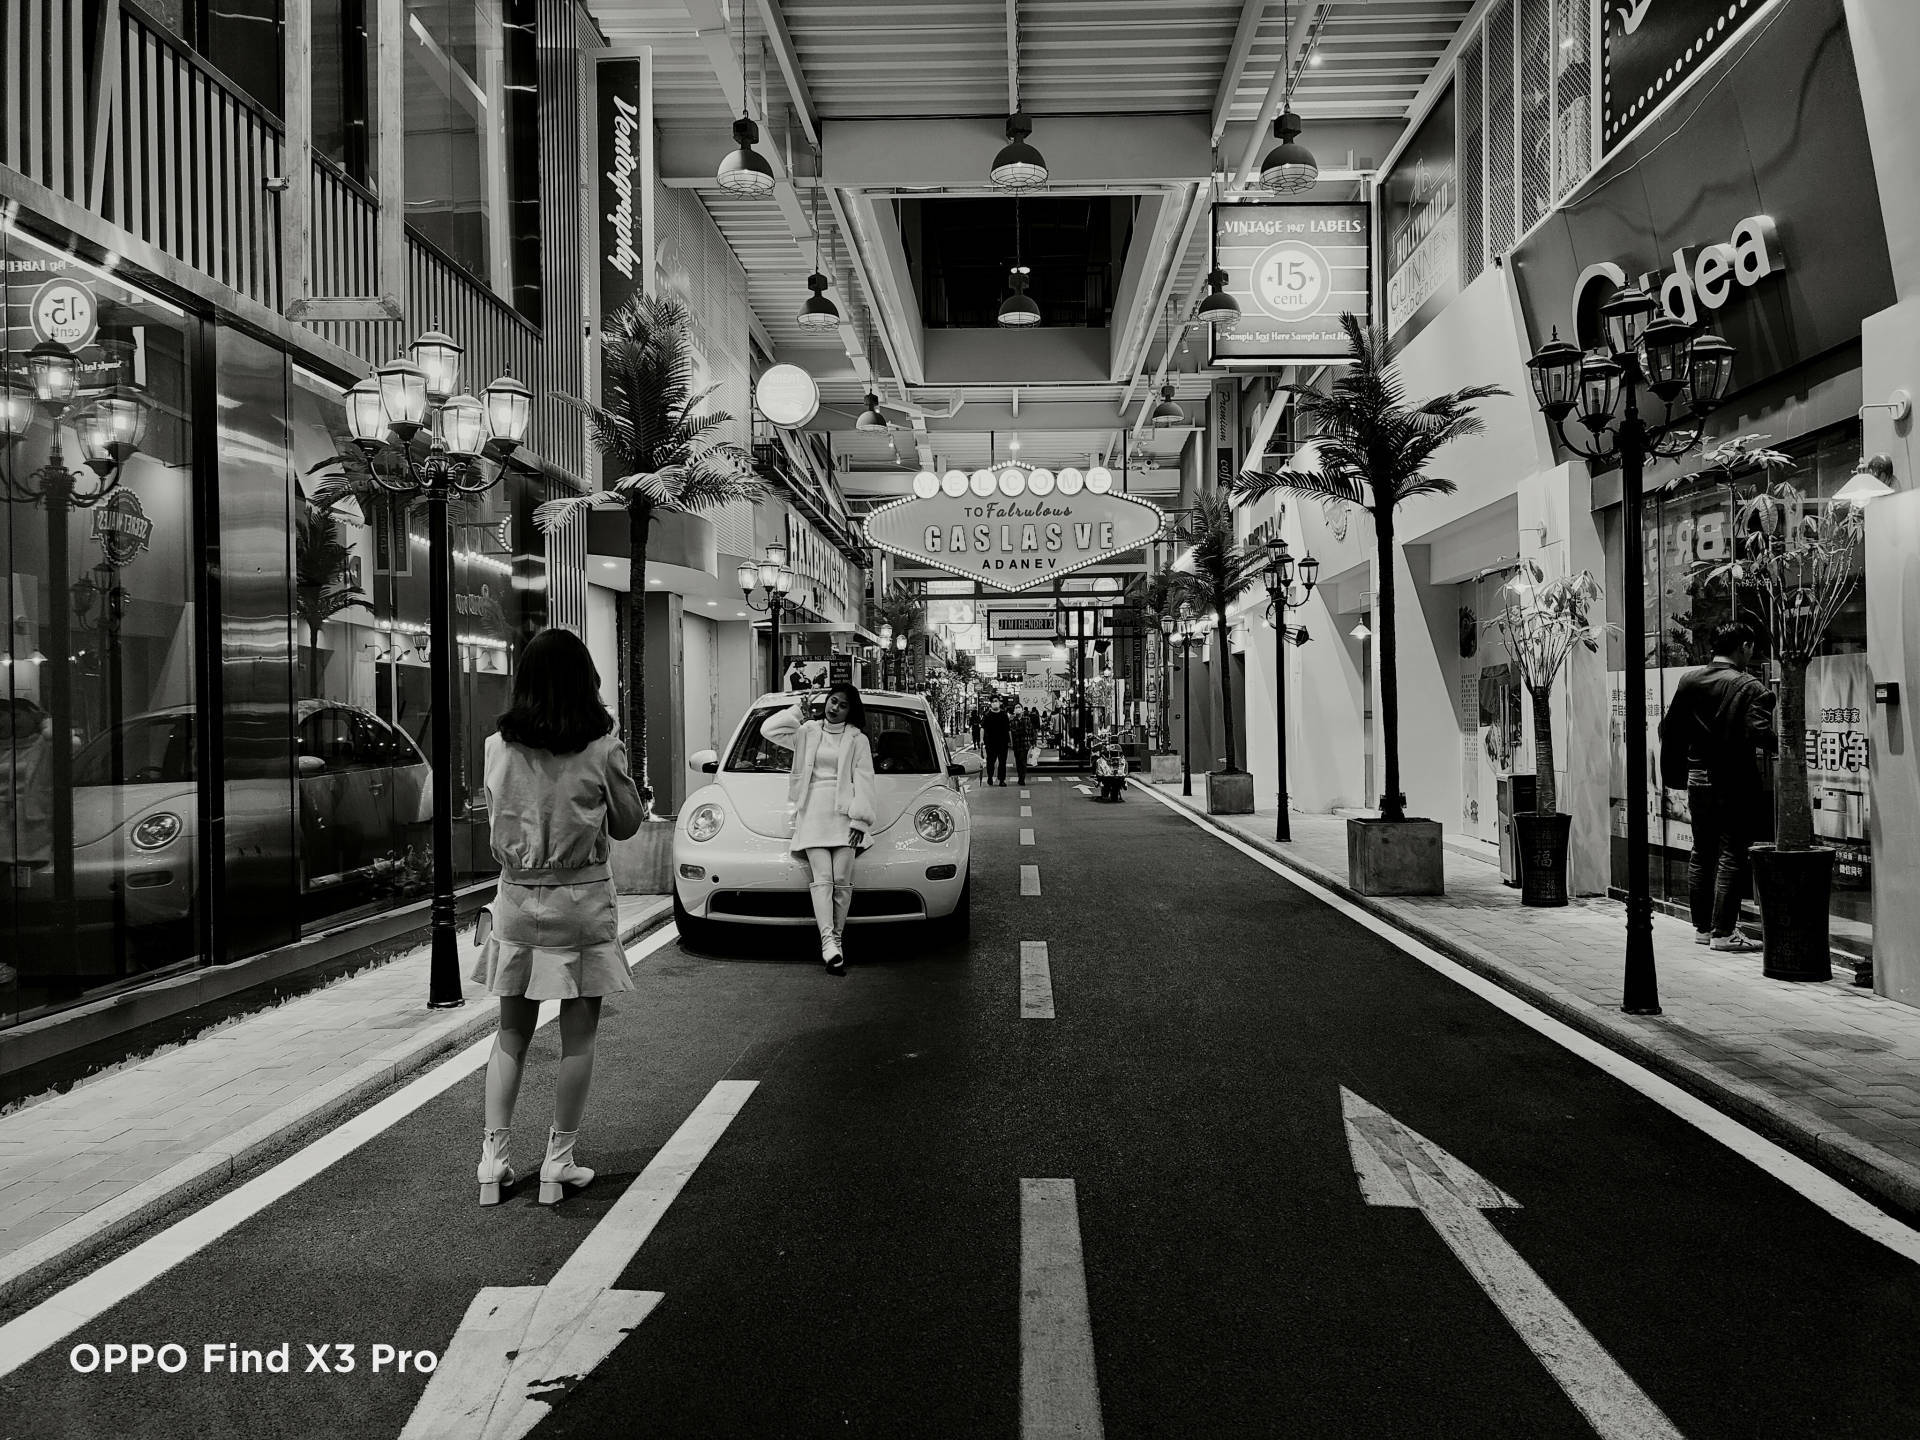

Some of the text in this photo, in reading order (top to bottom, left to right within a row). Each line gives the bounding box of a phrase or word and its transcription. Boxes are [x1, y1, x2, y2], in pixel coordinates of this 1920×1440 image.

[606, 95, 641, 280] Ventography
[1225, 220, 1361, 236] VINTAGE 1947 LABELS
[1396, 182, 1448, 268] HOLLYWOOD
[1275, 261, 1307, 291] 15
[1272, 332, 1290, 341] Here
[1292, 332, 1320, 342] Sample
[1321, 332, 1336, 341] Text
[1218, 390, 1231, 442] Premium
[964, 507, 983, 522] TO
[982, 558, 1056, 570] ADANEV
